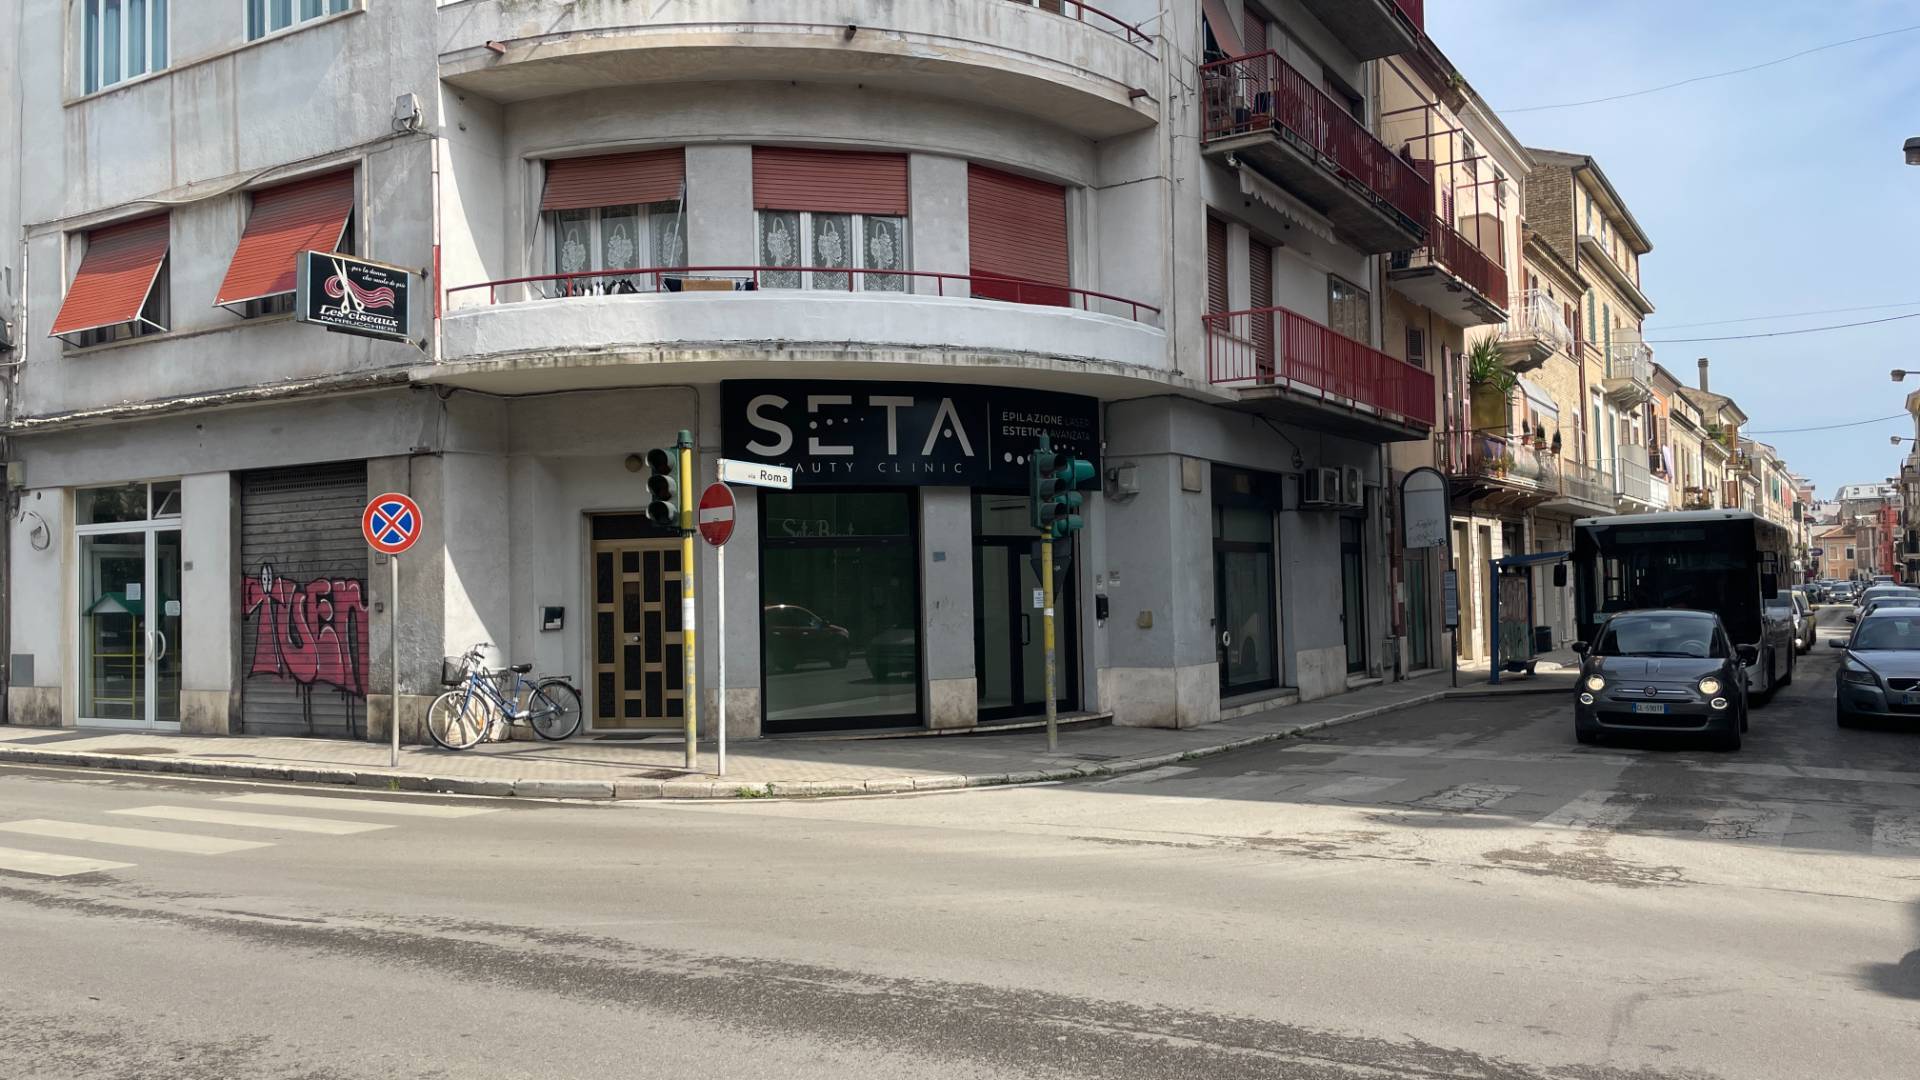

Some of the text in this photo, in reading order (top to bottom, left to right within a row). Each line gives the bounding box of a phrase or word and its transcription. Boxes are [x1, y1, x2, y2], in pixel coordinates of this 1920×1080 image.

[369, 268, 386, 277] donna
[319, 304, 398, 327] Les ciseaux
[320, 316, 397, 332] PARRUCCHIERI
[1002, 411, 1062, 425] EPILAZIONE
[745, 394, 975, 457] SETA
[1002, 426, 1048, 438] ESTETICA
[878, 462, 962, 473] CLINIC
[760, 470, 788, 483] Roma
